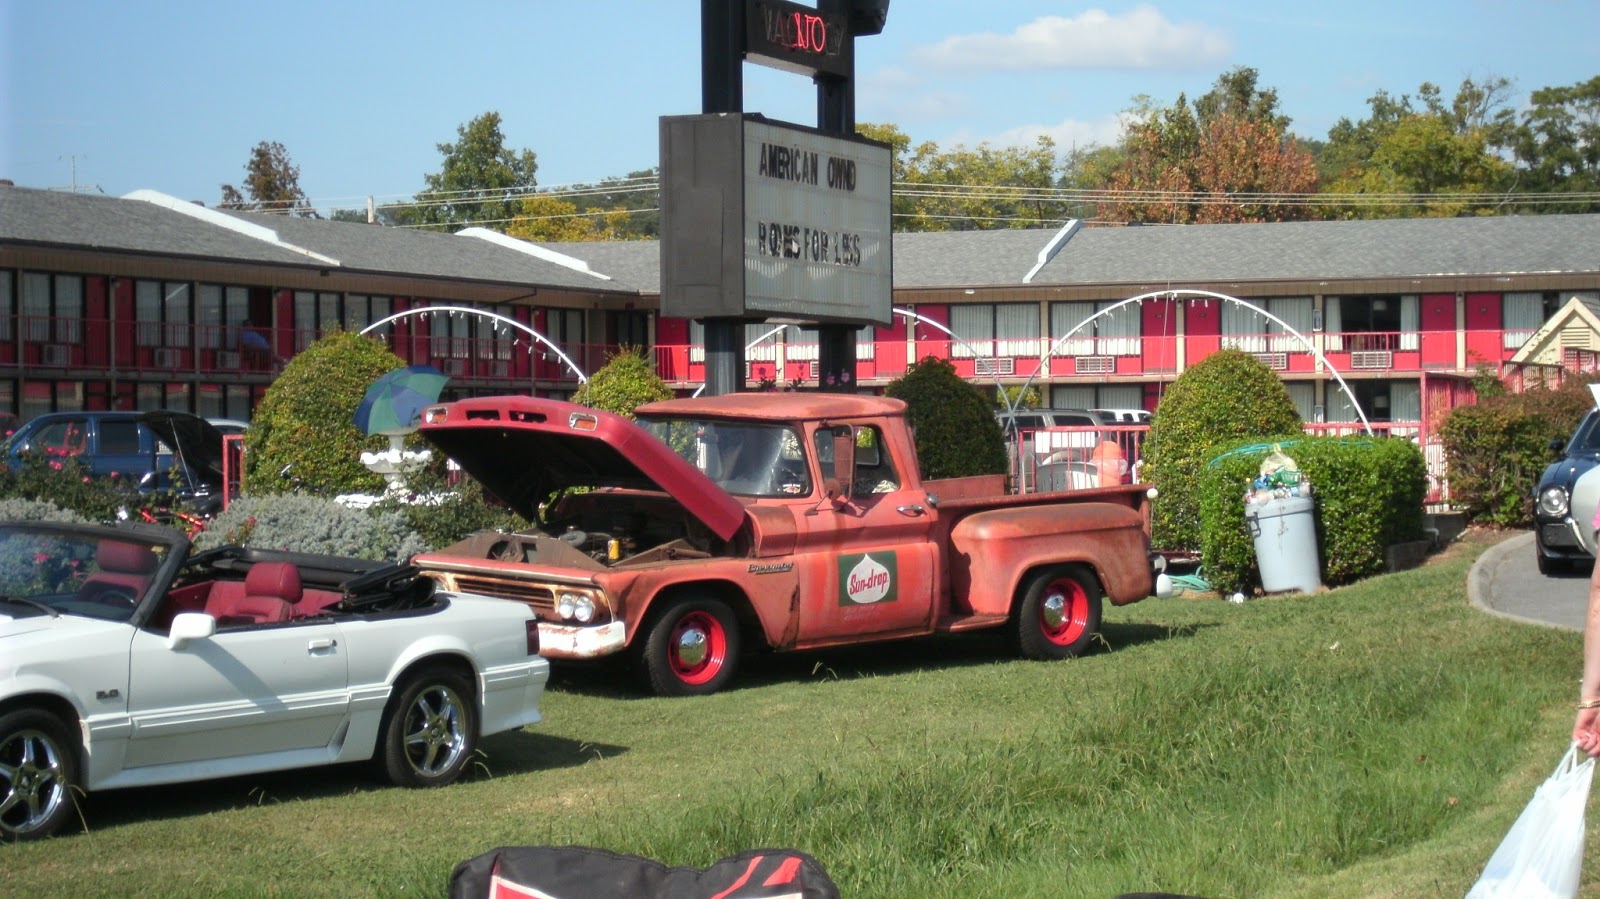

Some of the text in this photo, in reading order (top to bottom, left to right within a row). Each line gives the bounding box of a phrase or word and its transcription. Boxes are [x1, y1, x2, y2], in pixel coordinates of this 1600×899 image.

[794, 12, 826, 52] NO
[759, 142, 819, 185] AMERICAN
[804, 228, 829, 263] FOR
